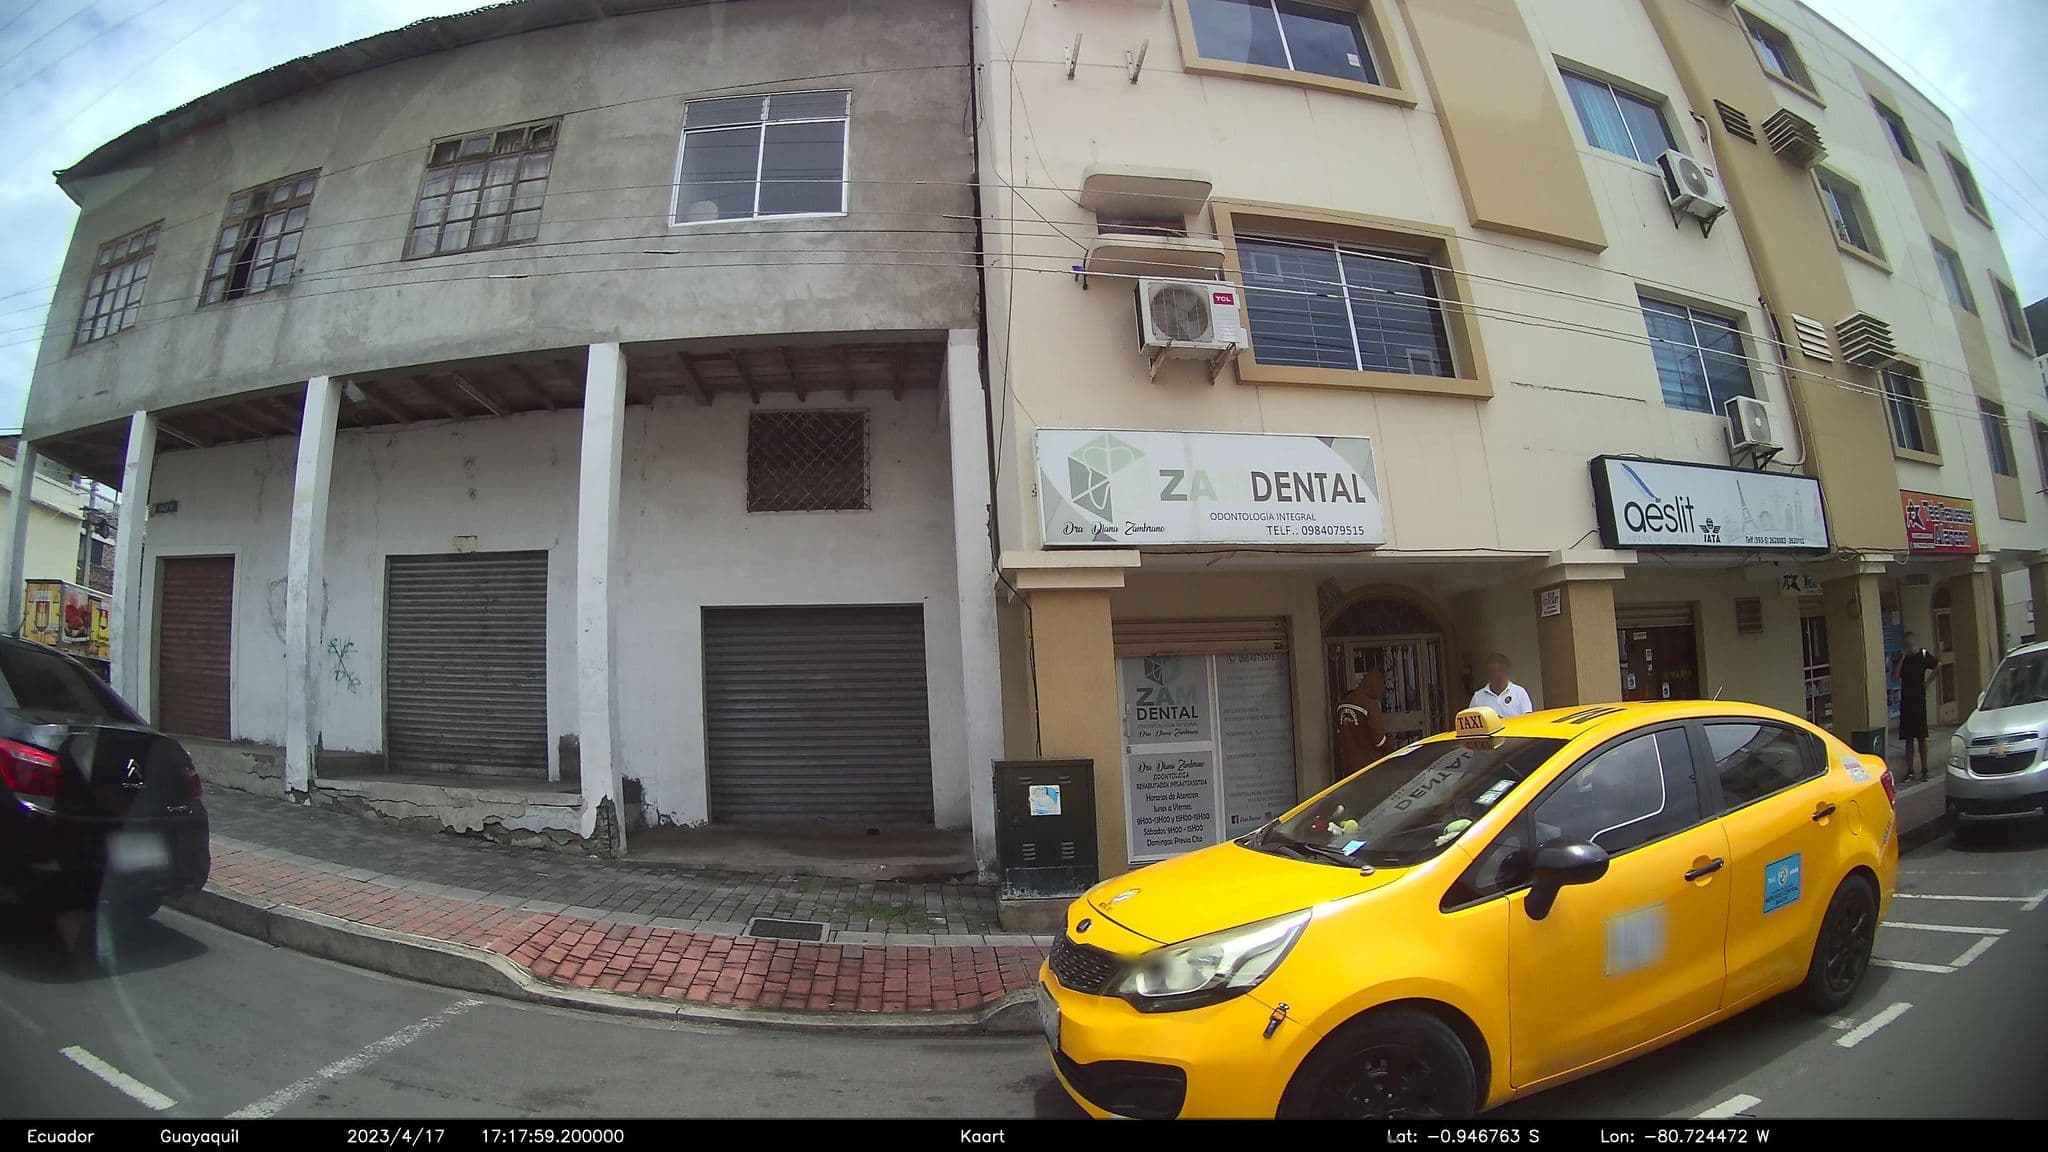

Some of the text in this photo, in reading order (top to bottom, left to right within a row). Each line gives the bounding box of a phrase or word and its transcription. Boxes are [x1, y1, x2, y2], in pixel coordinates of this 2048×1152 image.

[1250, 471, 1367, 503] DENTAL
[1276, 513, 1317, 521] INTEGRAL
[1124, 521, 1166, 535] Zambrano
[1301, 525, 1365, 536] 0984079515
[1703, 534, 1721, 543] IATA
[1136, 705, 1199, 721] DENTAL
[1457, 715, 1484, 730] TAXI
